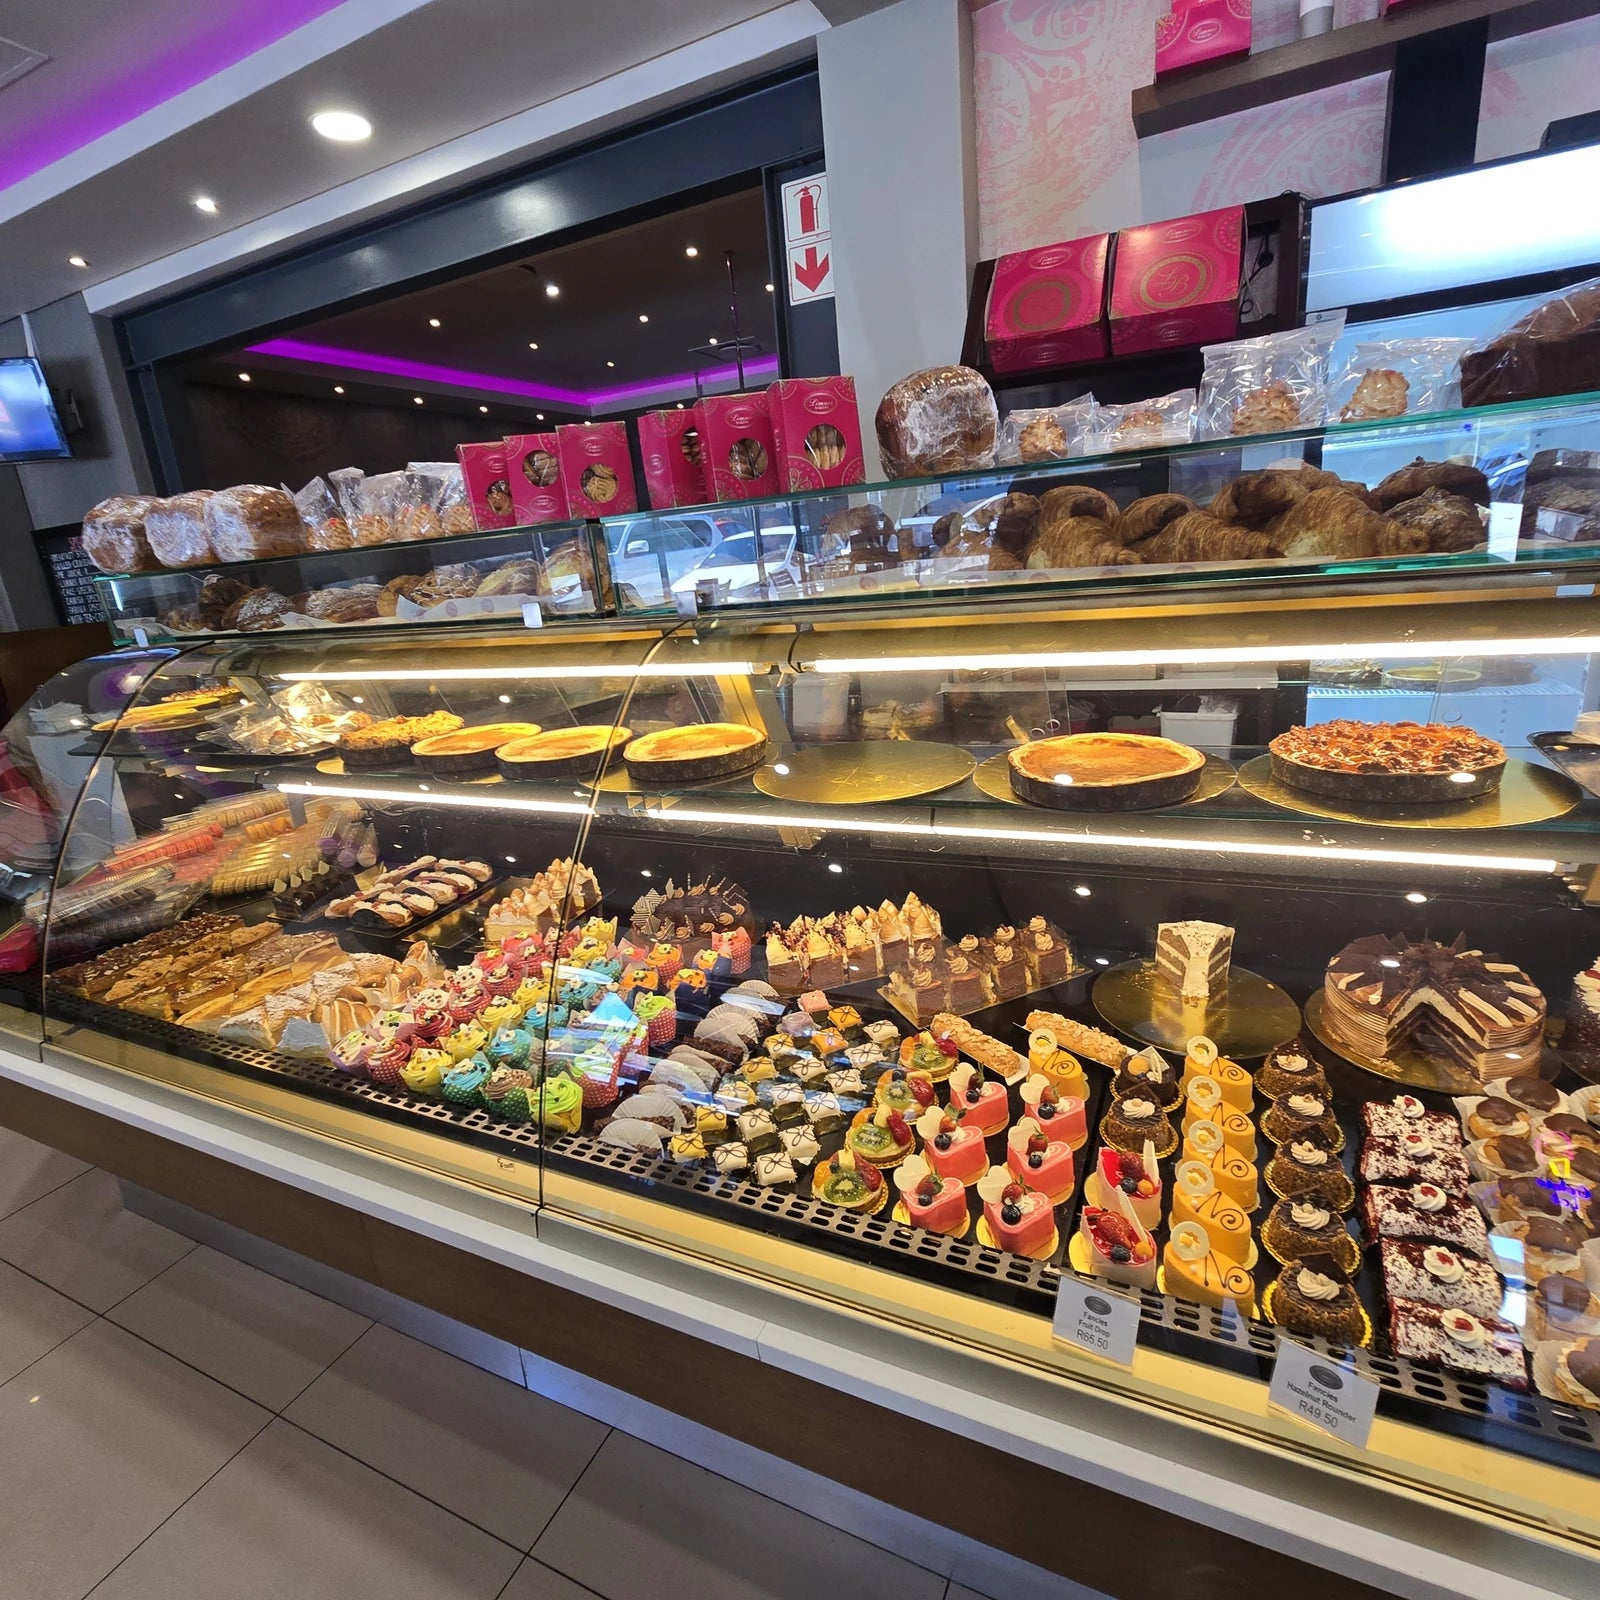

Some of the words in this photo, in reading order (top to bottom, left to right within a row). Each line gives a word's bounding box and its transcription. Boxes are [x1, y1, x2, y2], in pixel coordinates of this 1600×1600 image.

[1078, 1319, 1094, 1330] Fruit
[1094, 1325, 1111, 1338] Drop
[1083, 1311, 1108, 1327] Fancies
[1076, 1329, 1109, 1350] R65.50
[1287, 1381, 1320, 1404] Hazelnut
[1322, 1400, 1357, 1423] Rounder
[1308, 1381, 1338, 1403] Fancies
[1298, 1400, 1339, 1429] R49.50
